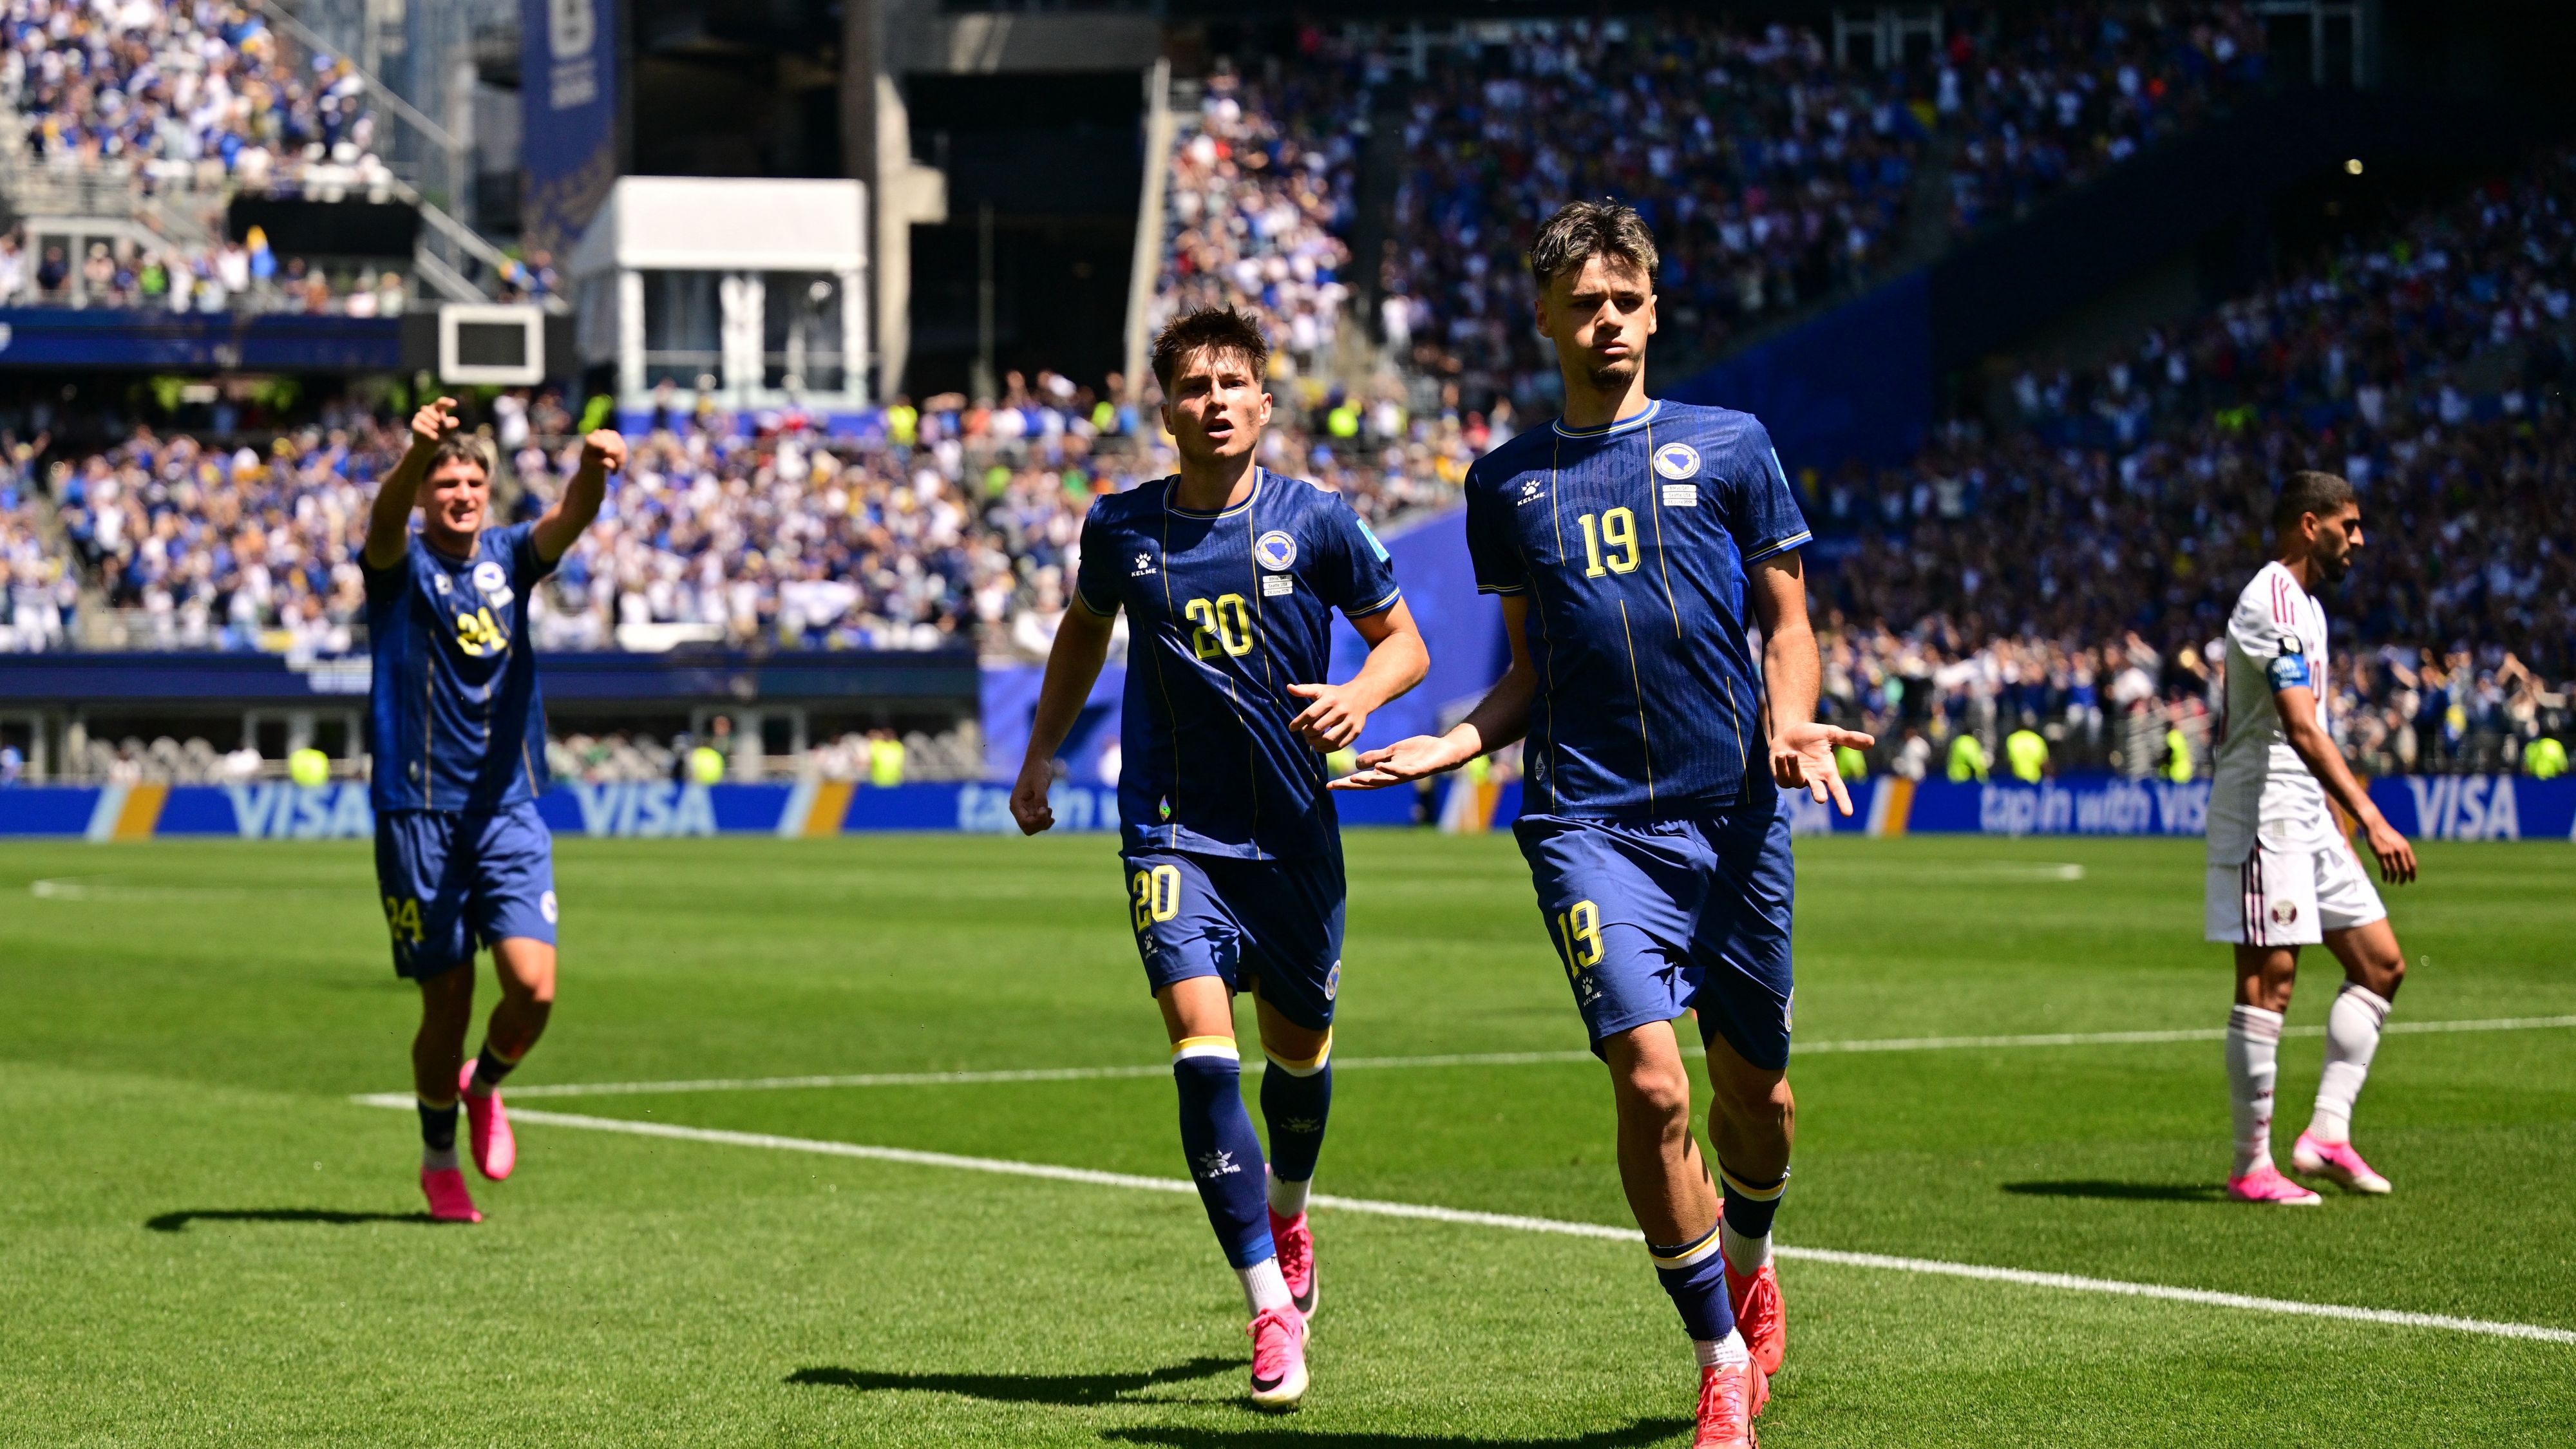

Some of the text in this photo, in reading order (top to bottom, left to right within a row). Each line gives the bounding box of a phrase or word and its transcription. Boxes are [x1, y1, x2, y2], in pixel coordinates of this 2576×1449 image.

[1517, 492, 1545, 506] KELME
[1131, 567, 1157, 578] KELME
[1578, 506, 1641, 578] 19
[457, 607, 507, 656] 24
[1185, 593, 1253, 661] 20
[220, 781, 375, 839] VISA
[567, 778, 718, 839] VISA
[1980, 775, 2211, 841] tap in with VIS
[2403, 772, 2521, 841] VISA
[1133, 865, 1181, 933] 20
[1558, 900, 1604, 980] 19
[1583, 990, 1602, 1008] KELME
